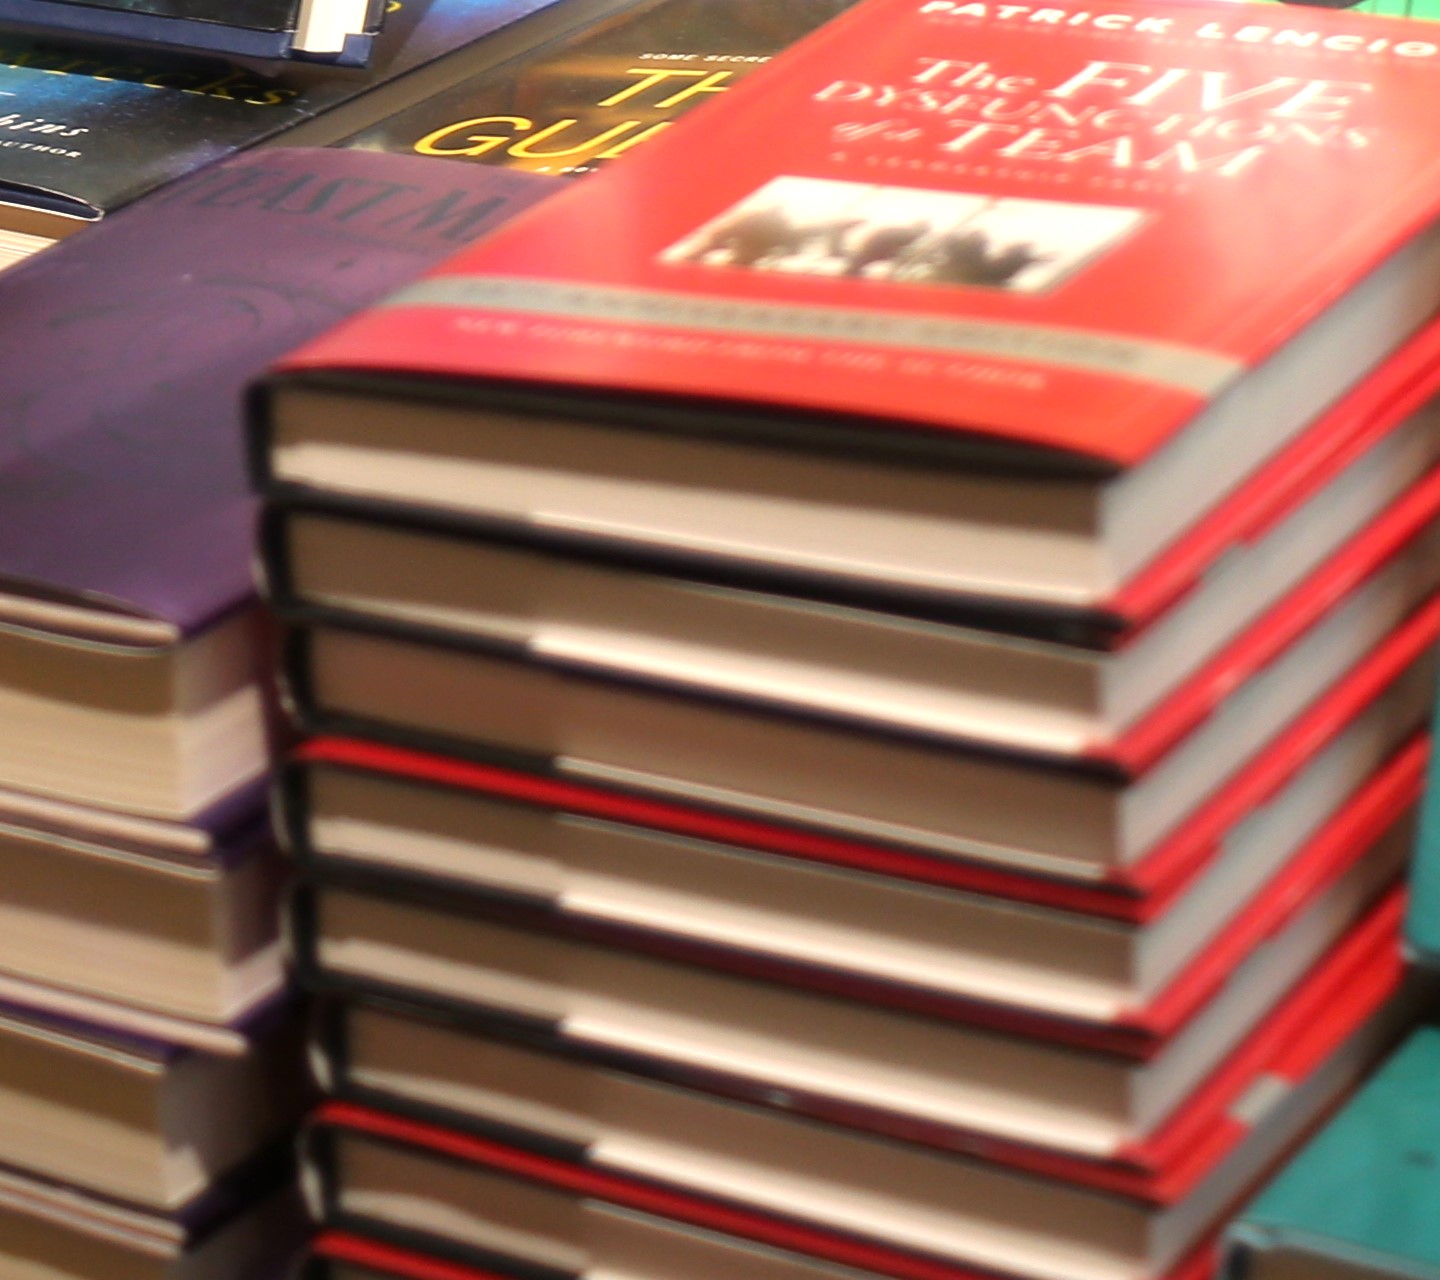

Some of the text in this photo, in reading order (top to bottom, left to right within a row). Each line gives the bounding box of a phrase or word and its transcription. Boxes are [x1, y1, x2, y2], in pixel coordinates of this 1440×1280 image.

[918, 0, 1175, 37] PATRICK
[638, 52, 700, 62] SOME
[814, 79, 1380, 151] DYSFUNCTIONS
[911, 56, 1376, 122] The FIVE
[938, 119, 1265, 177] TEAM
